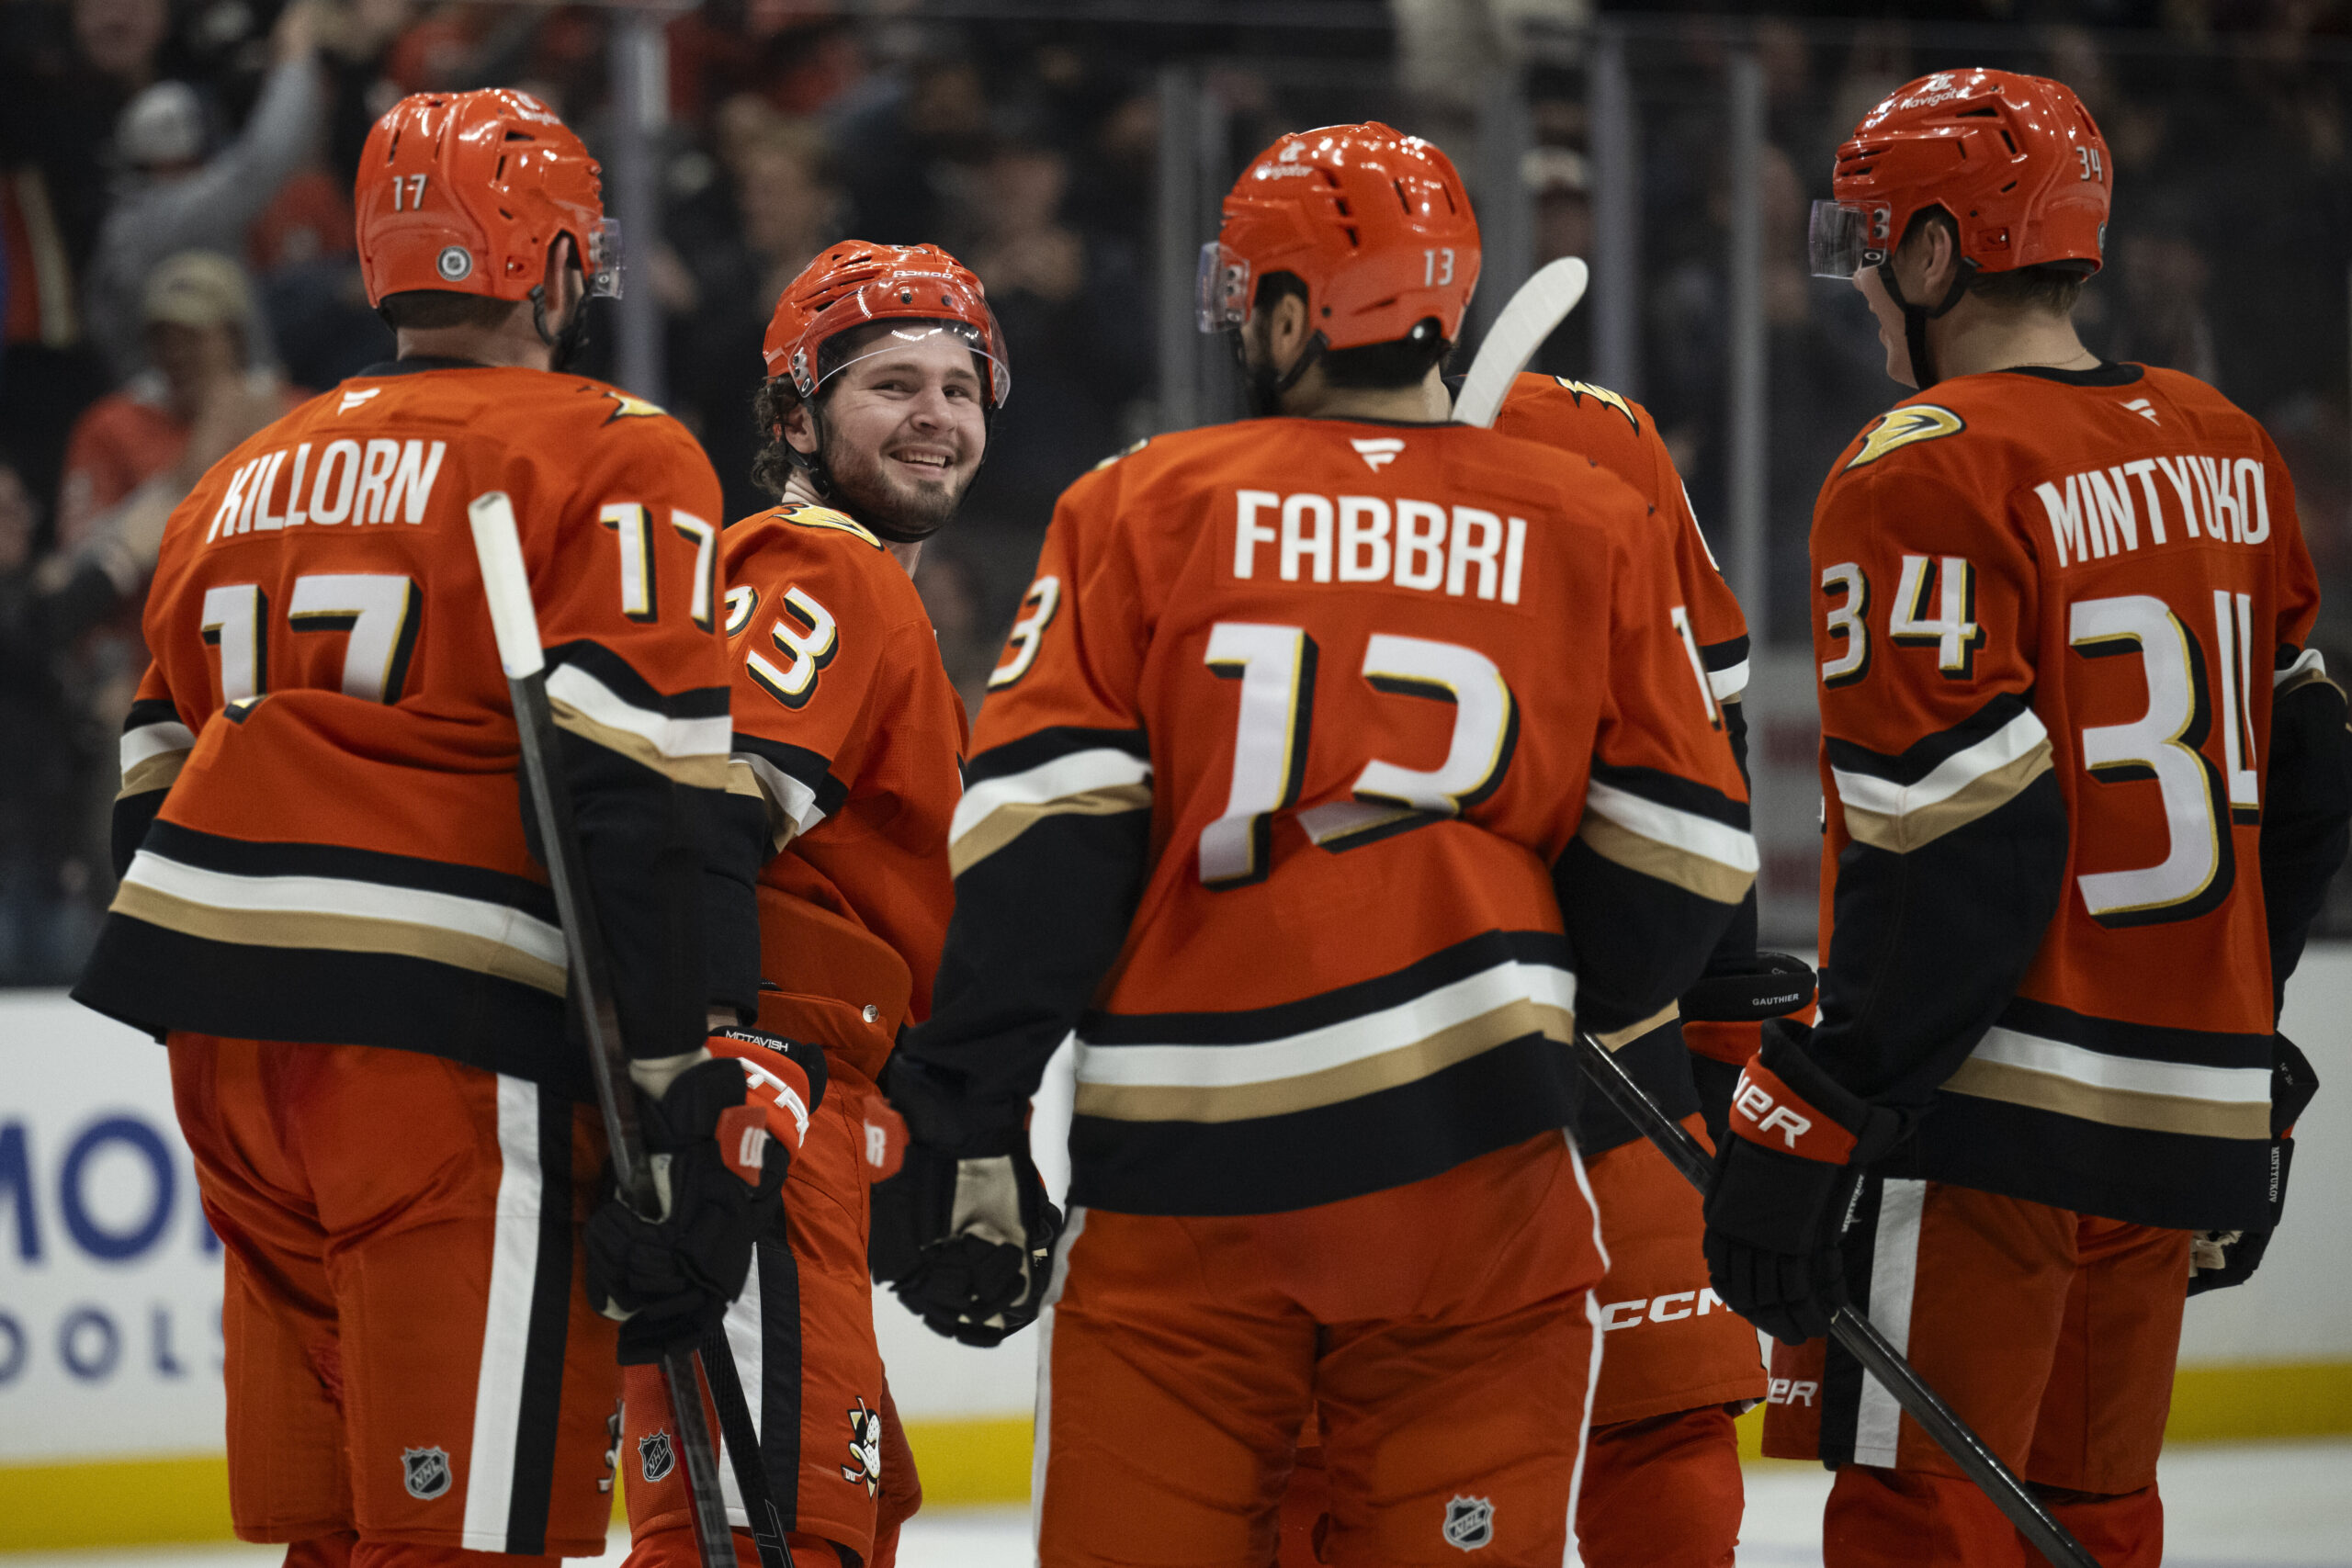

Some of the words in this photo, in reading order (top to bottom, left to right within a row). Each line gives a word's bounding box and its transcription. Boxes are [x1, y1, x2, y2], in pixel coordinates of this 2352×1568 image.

[2076, 145, 2103, 182] 34
[392, 173, 428, 212] 17
[1424, 247, 1454, 287] 13
[206, 438, 447, 545] KILLORN
[600, 502, 718, 636] 17
[1234, 490, 1527, 604] FABBRI
[1822, 555, 1987, 691] 34
[200, 573, 424, 725] 17
[1198, 622, 1521, 893] 13
[2069, 590, 2261, 930] 34
[1751, 992, 1800, 1007] GAUTHIER
[725, 1030, 789, 1053] MCTAVISH
[2268, 1146, 2281, 1203] MINTYUKOV
[413, 1460, 443, 1490] NHL
[649, 1442, 667, 1475] NHL
[1452, 1509, 1485, 1539] NHL
